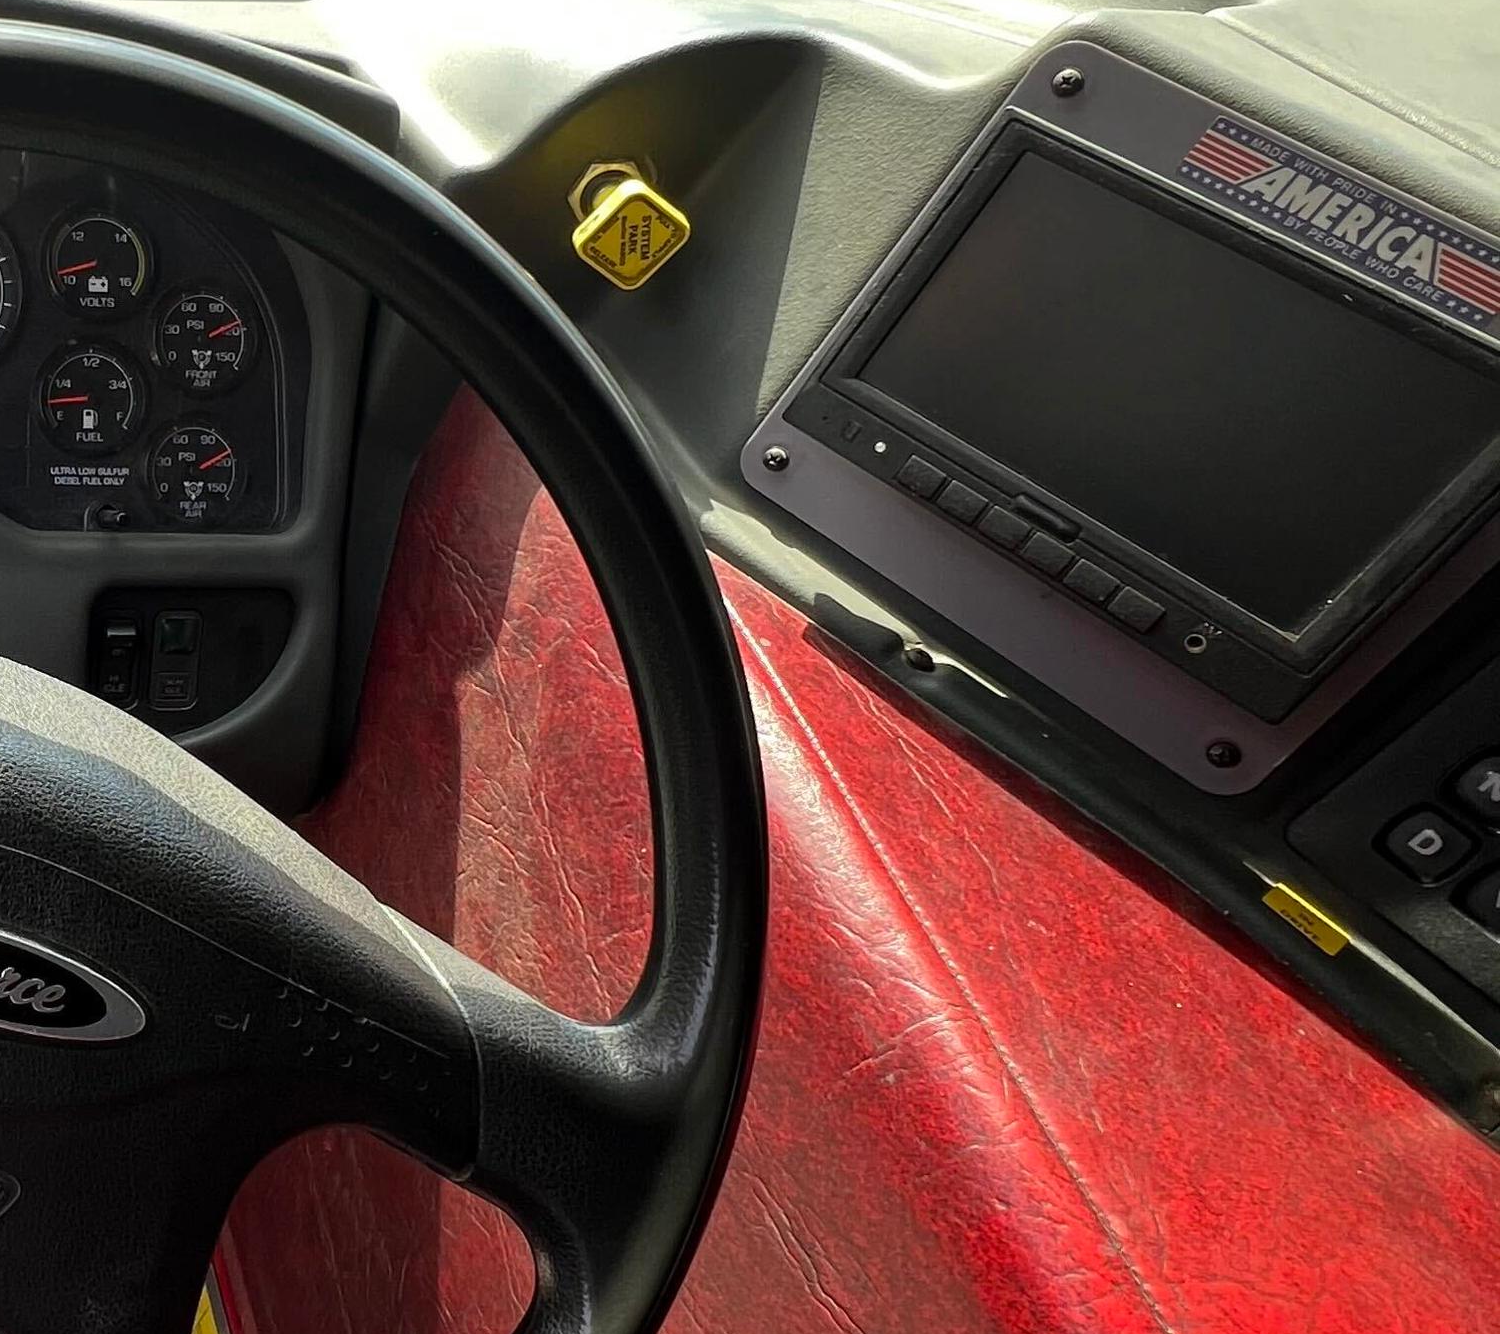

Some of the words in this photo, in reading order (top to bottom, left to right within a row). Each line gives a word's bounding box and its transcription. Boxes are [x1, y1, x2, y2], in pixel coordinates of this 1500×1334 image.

[1251, 137, 1291, 162] MADE
[1293, 152, 1329, 181] WITH
[1332, 175, 1377, 205] PRIDE
[1379, 196, 1399, 215] IN
[1239, 166, 1436, 283] AMERICA
[71, 231, 85, 242] 12
[114, 233, 128, 243] 14
[627, 224, 639, 255] PARK
[640, 214, 653, 261] SYSTEM
[1282, 216, 1307, 233] BY
[1306, 227, 1361, 261] PEOPLE
[1364, 256, 1400, 280] WHO
[1402, 274, 1450, 303] CARE
[63, 275, 76, 285] 10
[119, 277, 132, 287] 16
[79, 297, 115, 308] VOLTS
[164, 325, 180, 335] 30
[186, 319, 205, 330] PSI
[168, 350, 177, 361] 0
[215, 352, 236, 362] 150
[82, 357, 100, 367] 1/2
[185, 370, 217, 379] FRONT
[55, 378, 71, 388] 1/4
[108, 379, 127, 390] 3/4
[56, 411, 64, 421] E
[116, 412, 124, 421] F
[76, 431, 104, 442] FUEL
[173, 434, 189, 444] 60
[200, 435, 216, 445] 90
[178, 451, 196, 462] PSI
[50, 466, 77, 475] ULTRA
[77, 467, 96, 475] LOW
[54, 476, 81, 485] DIESEL
[82, 476, 102, 485] FUEL
[103, 477, 125, 486] ONLY
[160, 482, 169, 493] 0
[207, 482, 227, 493] 150
[1407, 828, 1444, 856] D
